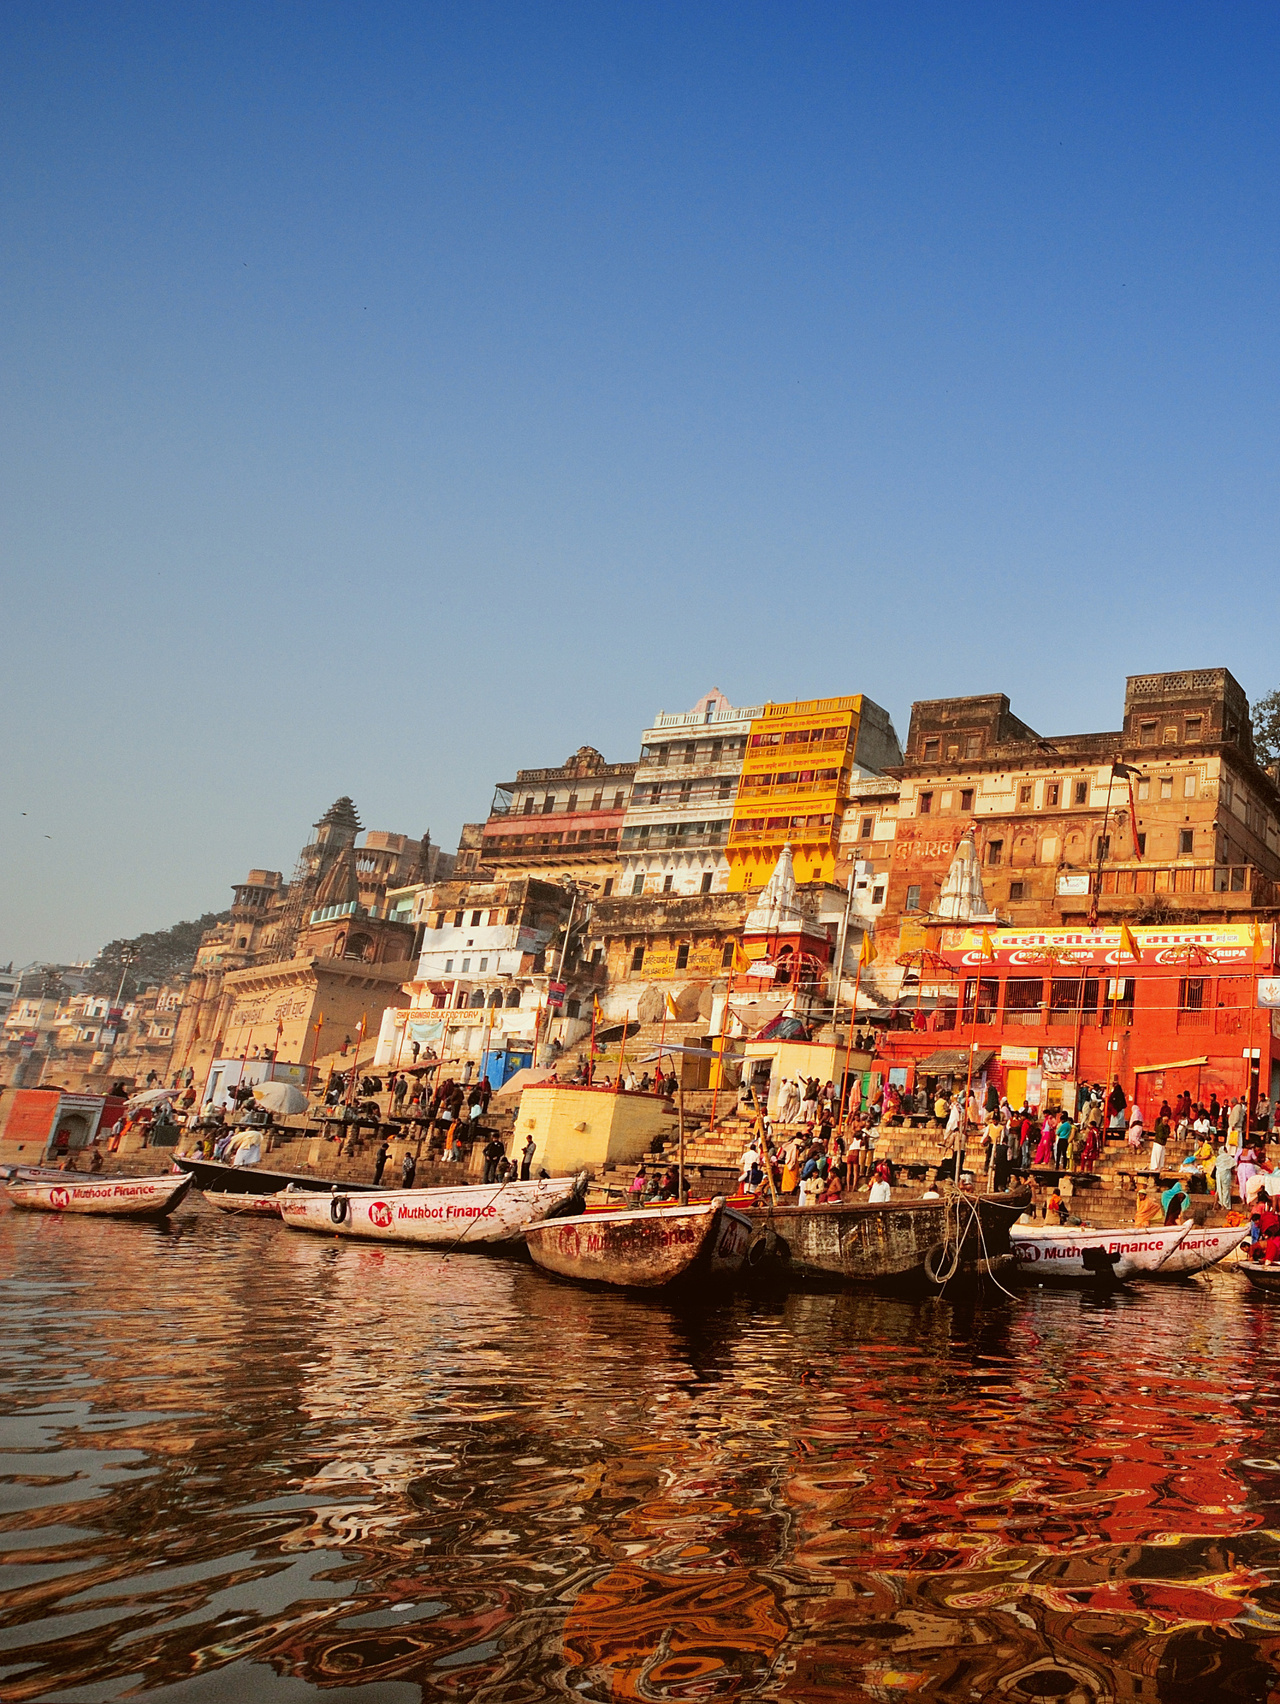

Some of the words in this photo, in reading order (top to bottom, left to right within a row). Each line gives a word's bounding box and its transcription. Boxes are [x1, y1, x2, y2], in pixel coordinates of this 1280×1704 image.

[431, 1011, 446, 1019] SILK
[446, 1011, 479, 1019] FACTORY
[72, 1188, 111, 1199] Muthoot
[113, 1185, 155, 1197] Finance
[398, 1204, 443, 1219] Muthoot
[446, 1206, 497, 1218] Finance
[1108, 1240, 1164, 1255] Finance
[1178, 1237, 1219, 1250] inance
